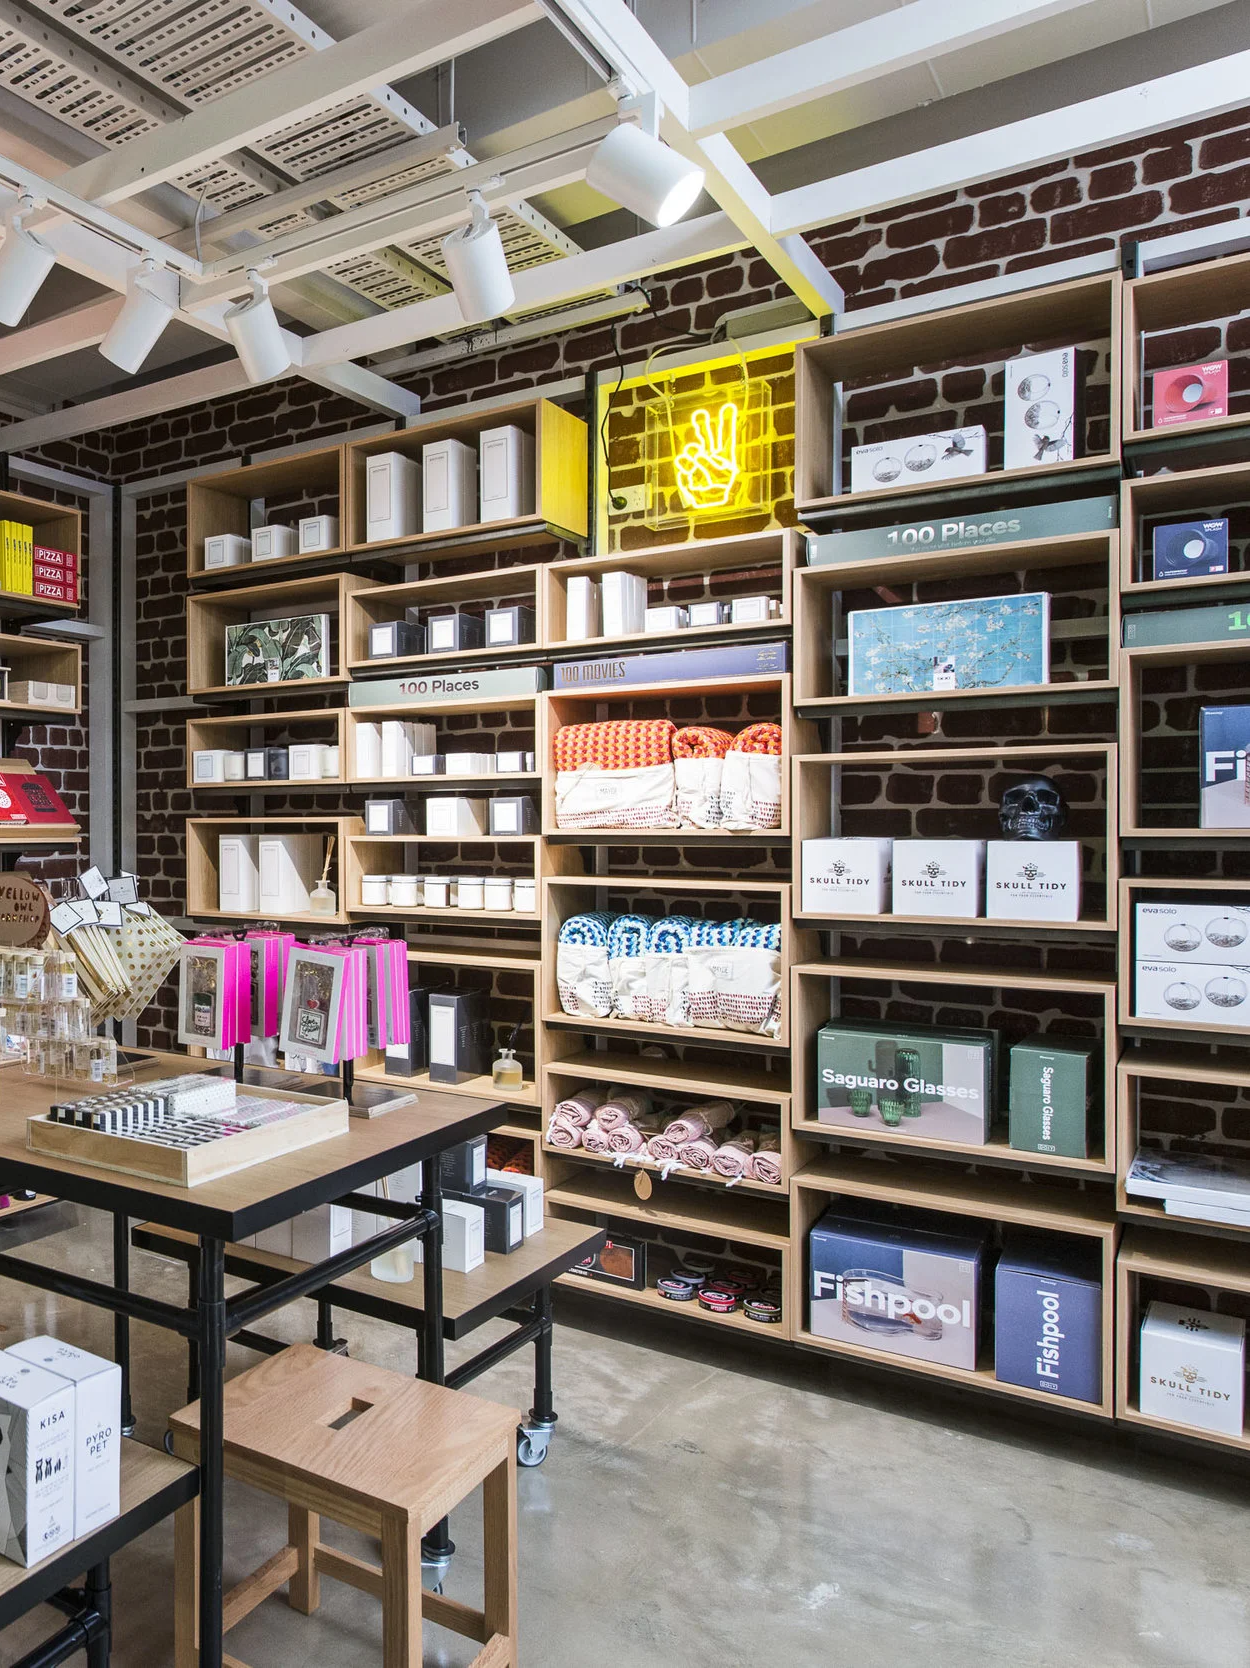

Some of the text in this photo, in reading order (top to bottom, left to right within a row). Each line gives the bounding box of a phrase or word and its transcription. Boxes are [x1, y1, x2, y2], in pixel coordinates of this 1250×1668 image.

[1202, 363, 1222, 372] WOW
[887, 517, 1022, 547] 100 Places
[1203, 521, 1224, 530] WOW
[39, 549, 62, 563] PIZZA
[39, 565, 62, 580] PIZZA
[39, 583, 62, 597] PIZZA
[561, 660, 626, 682] 100 MOVIES
[399, 679, 480, 695] 100 Places
[809, 877, 870, 886] SKULL TIDY
[901, 879, 967, 888] SKULL TIDY
[996, 881, 1068, 890] SKULL TIDY
[14, 902, 33, 912] OWL
[1159, 907, 1177, 915] solo
[822, 1067, 980, 1100] Saguaro Glasses
[1040, 1066, 1054, 1141] Saguaro Glasses
[813, 1270, 971, 1329] Fishpool
[1036, 1290, 1065, 1378] Fishpool
[1150, 1376, 1231, 1401] SKULL TIDY
[40, 1410, 66, 1431] KISA
[85, 1427, 112, 1447] PYRO
[90, 1439, 108, 1457] PET
